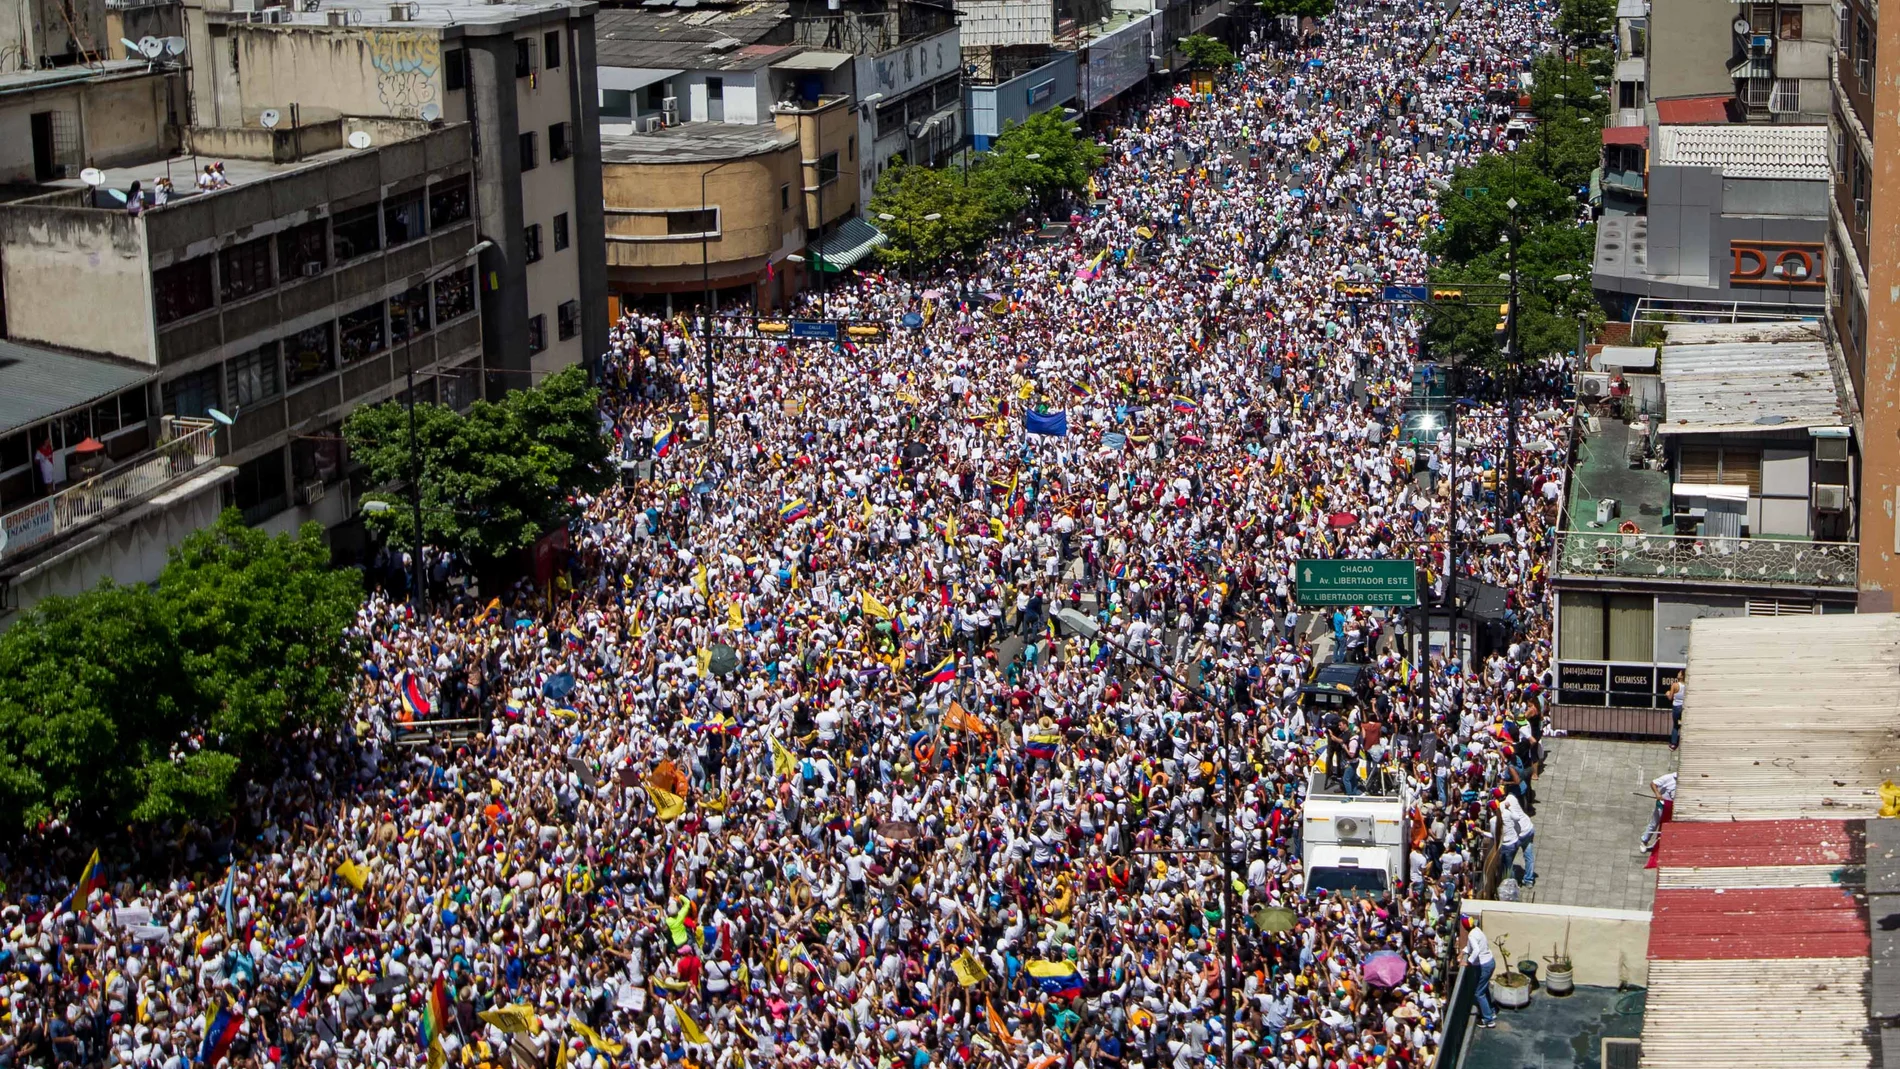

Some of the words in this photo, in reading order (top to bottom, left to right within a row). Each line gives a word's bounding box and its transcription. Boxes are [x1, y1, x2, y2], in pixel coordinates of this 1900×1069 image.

[1340, 565, 1374, 573] CHACAO
[1319, 577, 1331, 585] Av.
[1333, 577, 1384, 585] LIBERTADOR
[1387, 577, 1408, 585] ESTE
[1300, 593, 1312, 601] Av.
[1314, 593, 1365, 601] LIBERTADOR
[1367, 593, 1394, 601] OESTE
[1614, 675, 1648, 685] CHEMISSES
